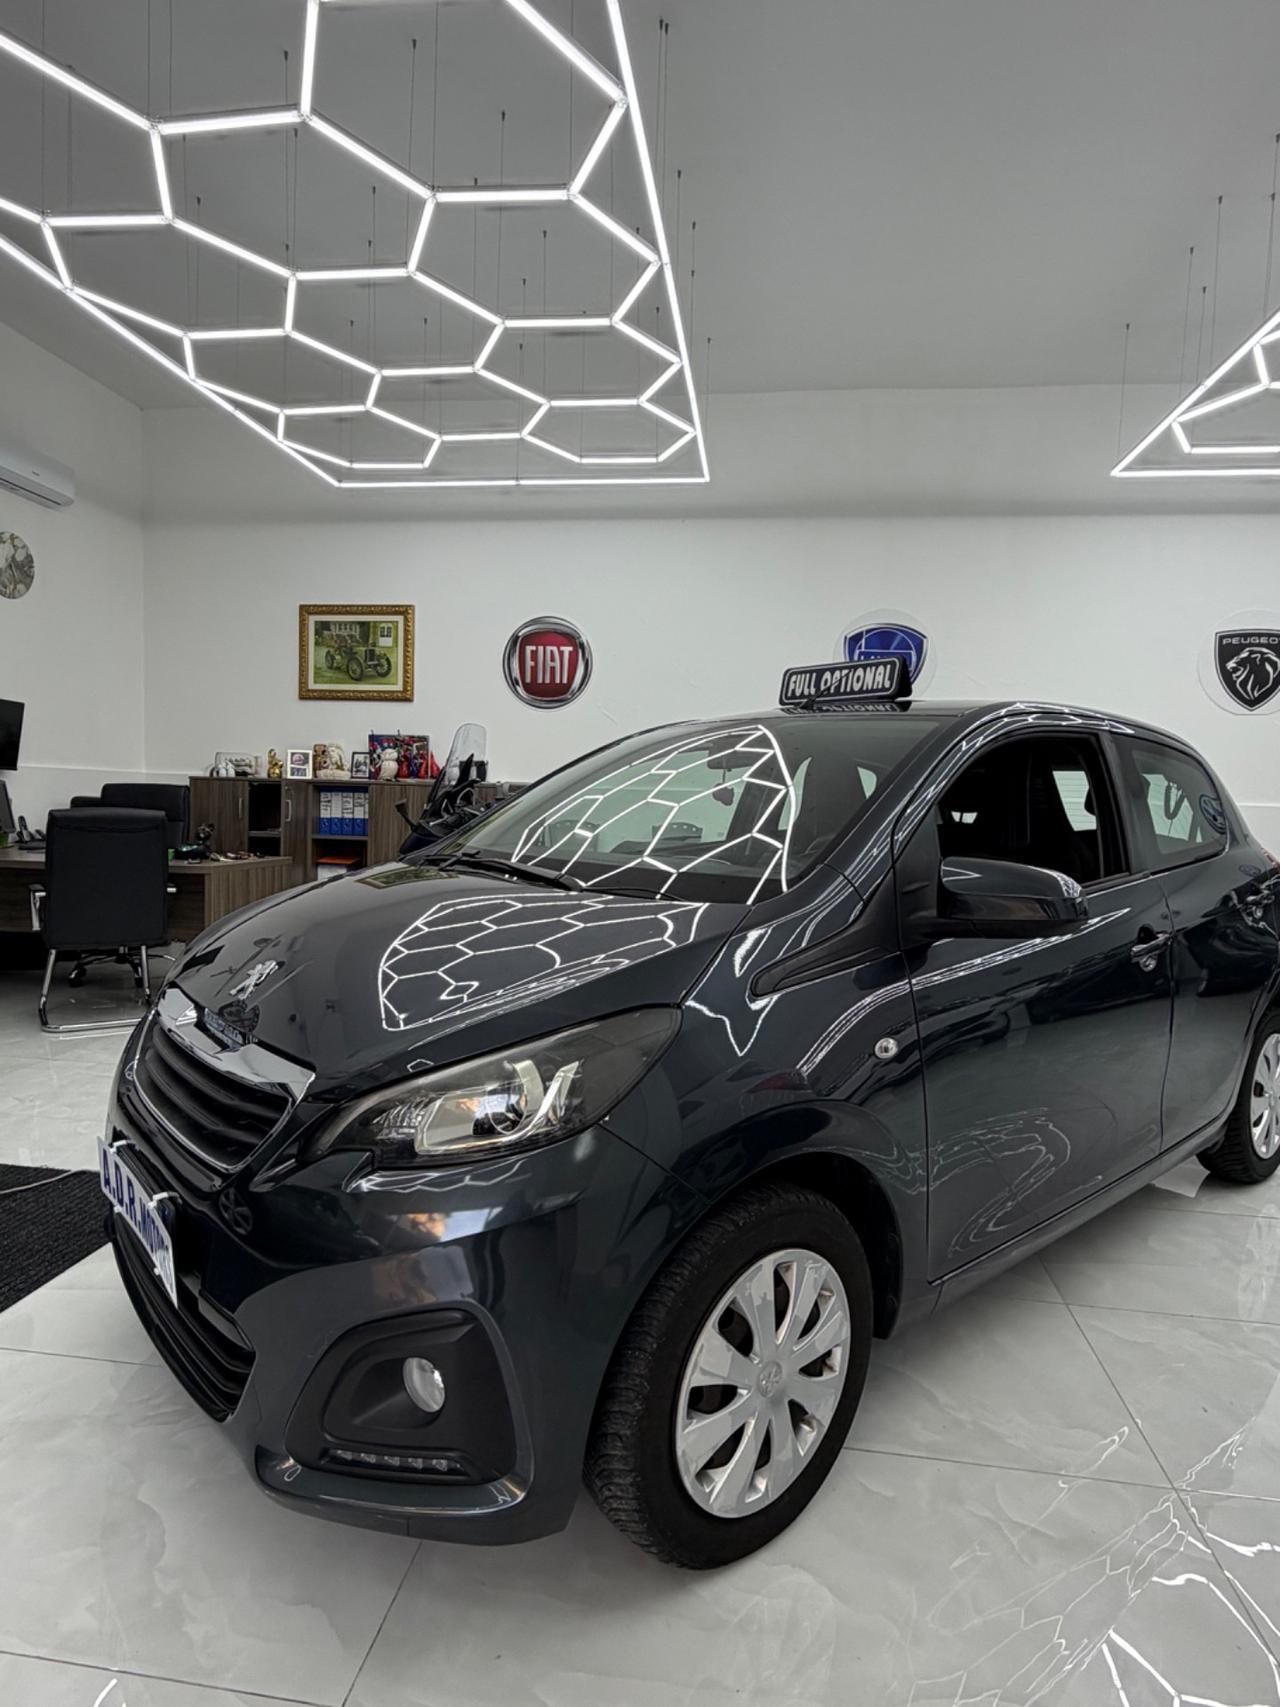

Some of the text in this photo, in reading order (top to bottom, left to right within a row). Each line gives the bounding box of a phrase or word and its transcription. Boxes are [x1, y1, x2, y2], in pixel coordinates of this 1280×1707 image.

[1222, 636, 1280, 645] PEUGEO
[525, 645, 573, 684] FIAT
[787, 664, 892, 698] FULL OPTIONAL
